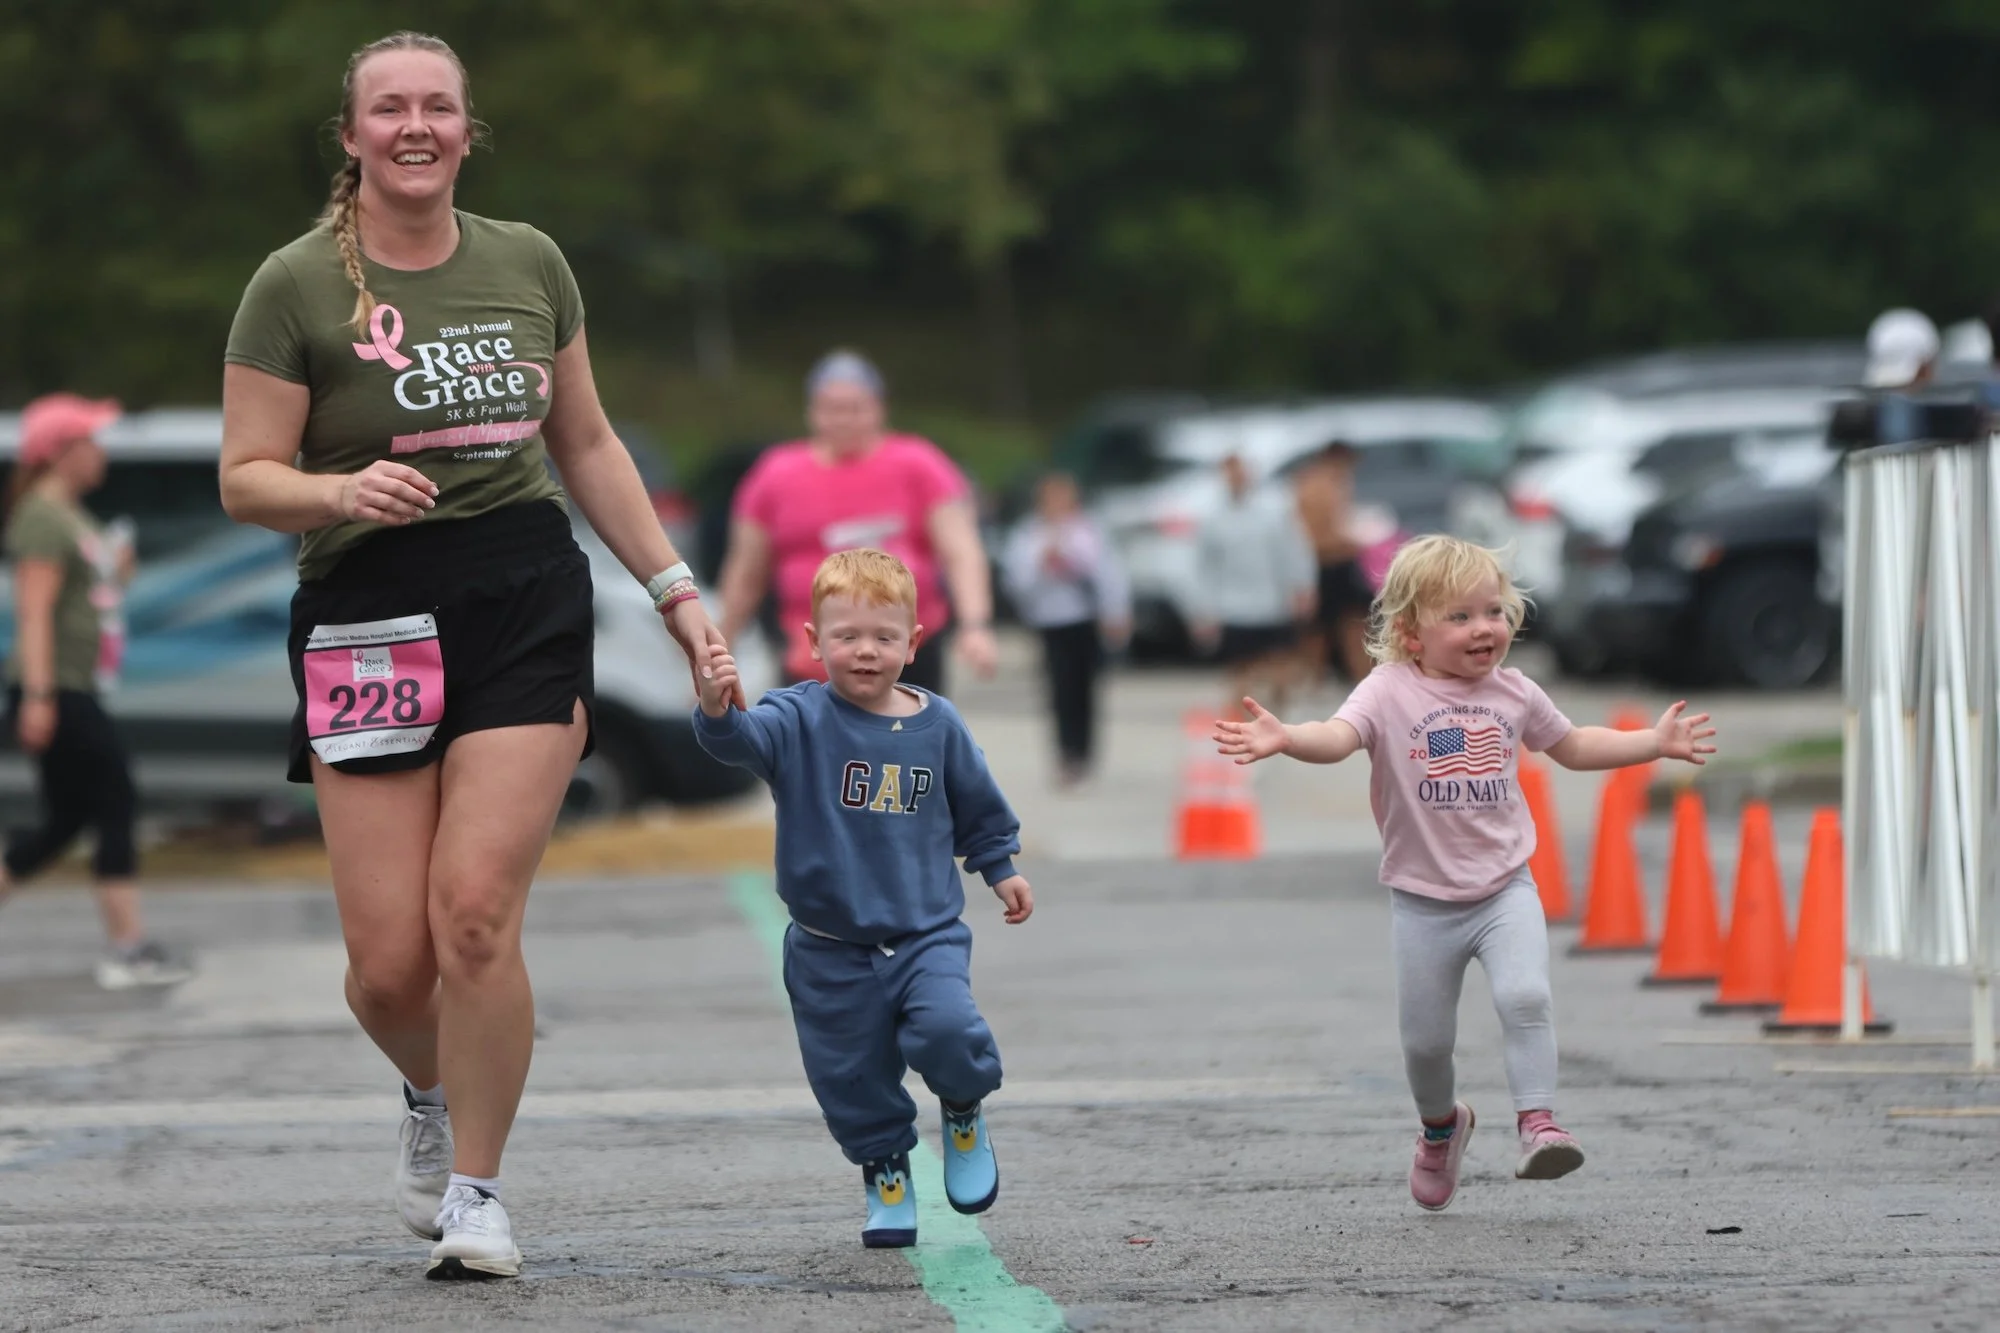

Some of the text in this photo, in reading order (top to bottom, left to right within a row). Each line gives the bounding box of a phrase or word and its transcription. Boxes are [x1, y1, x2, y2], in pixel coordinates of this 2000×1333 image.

[439, 320, 513, 338] 22nd Annual
[412, 337, 515, 383] Race
[467, 363, 496, 375] With
[393, 370, 526, 411] Grace
[446, 400, 528, 422] 5K & Fun Walk
[454, 446, 513, 461] September
[370, 632, 393, 640] Hospital
[394, 628, 418, 637] Medical
[329, 679, 422, 730] 228
[1410, 705, 1514, 740] CELEBRATING 250 YEARS
[1409, 749, 1427, 760] 20
[840, 760, 933, 814] GAP
[1418, 778, 1509, 802] OLD NAVY
